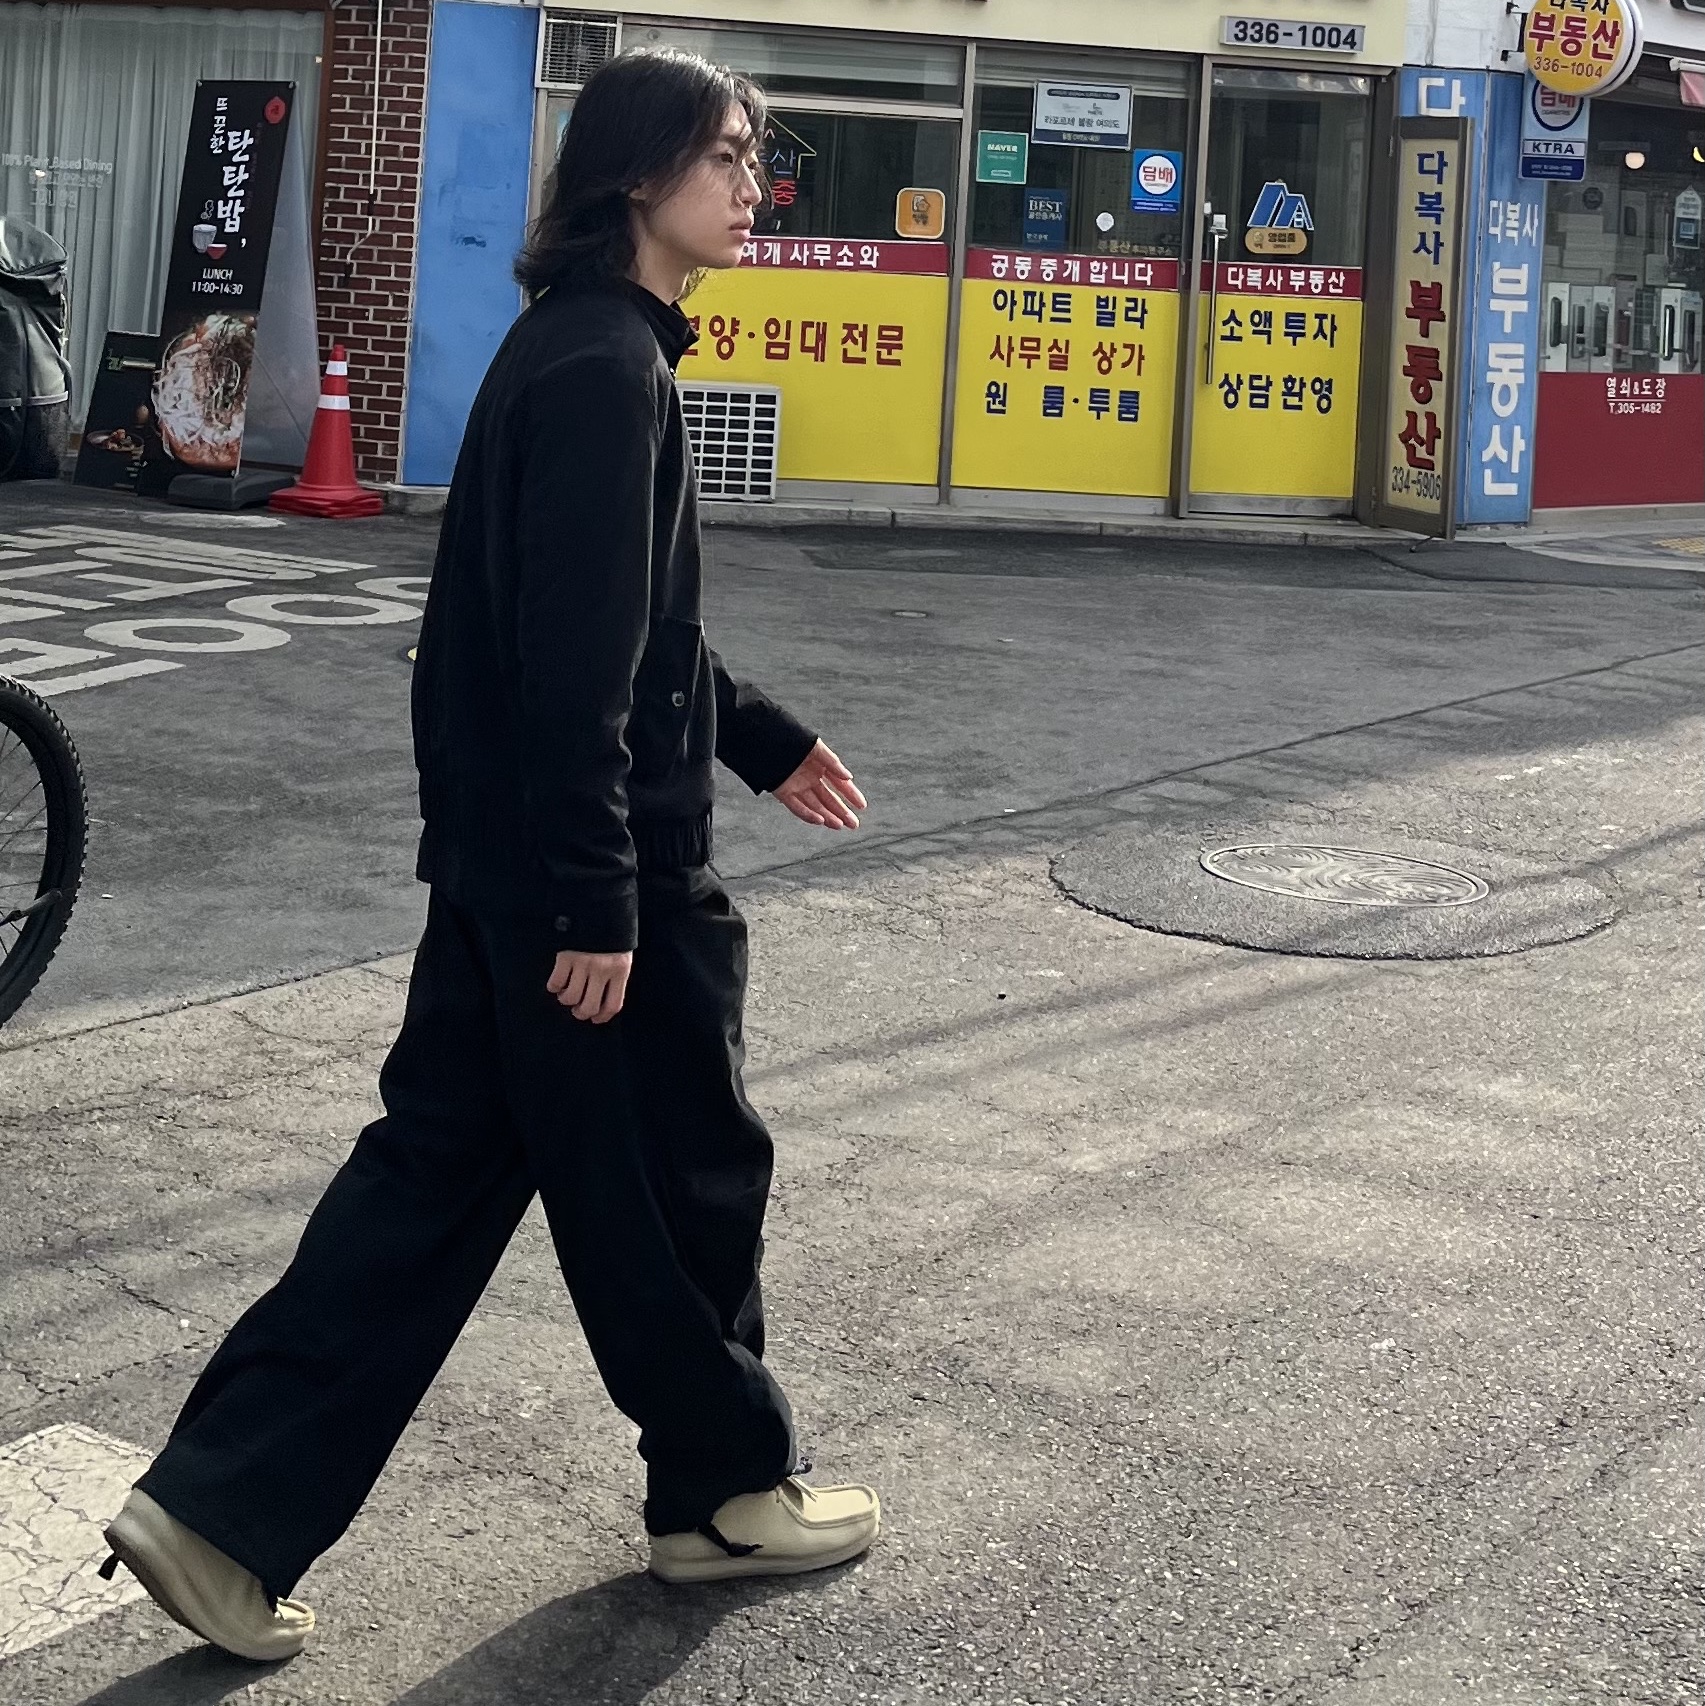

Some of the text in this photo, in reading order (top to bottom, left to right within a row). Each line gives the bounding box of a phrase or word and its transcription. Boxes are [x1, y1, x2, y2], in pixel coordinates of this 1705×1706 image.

[1234, 20, 1357, 49] 336-1004
[1529, 12, 1620, 60] 부동산
[1533, 56, 1603, 79] 336-1004
[209, 97, 229, 154] 뜨끈한
[987, 143, 1018, 153] NAVER
[1532, 142, 1575, 155] KTRA
[83, 158, 112, 175] Dining
[1029, 199, 1063, 213] BEST
[1489, 200, 1539, 246] 다복사
[789, 244, 880, 269] 사무소와
[202, 268, 233, 281] LUNCH
[1089, 260, 1154, 286] 합니다
[1227, 267, 1346, 294] 다복사 부동산
[191, 281, 244, 295] 11:00-14:30
[992, 288, 1148, 330] 아파트 빌라
[1399, 151, 1449, 471] 다복사 부동산
[1220, 309, 1338, 348] 소액 투자
[841, 322, 904, 366] 전문
[989, 334, 1145, 376] 사무실 상가
[1218, 372, 1334, 414] 상담 환영
[1481, 262, 1529, 496] 부동산
